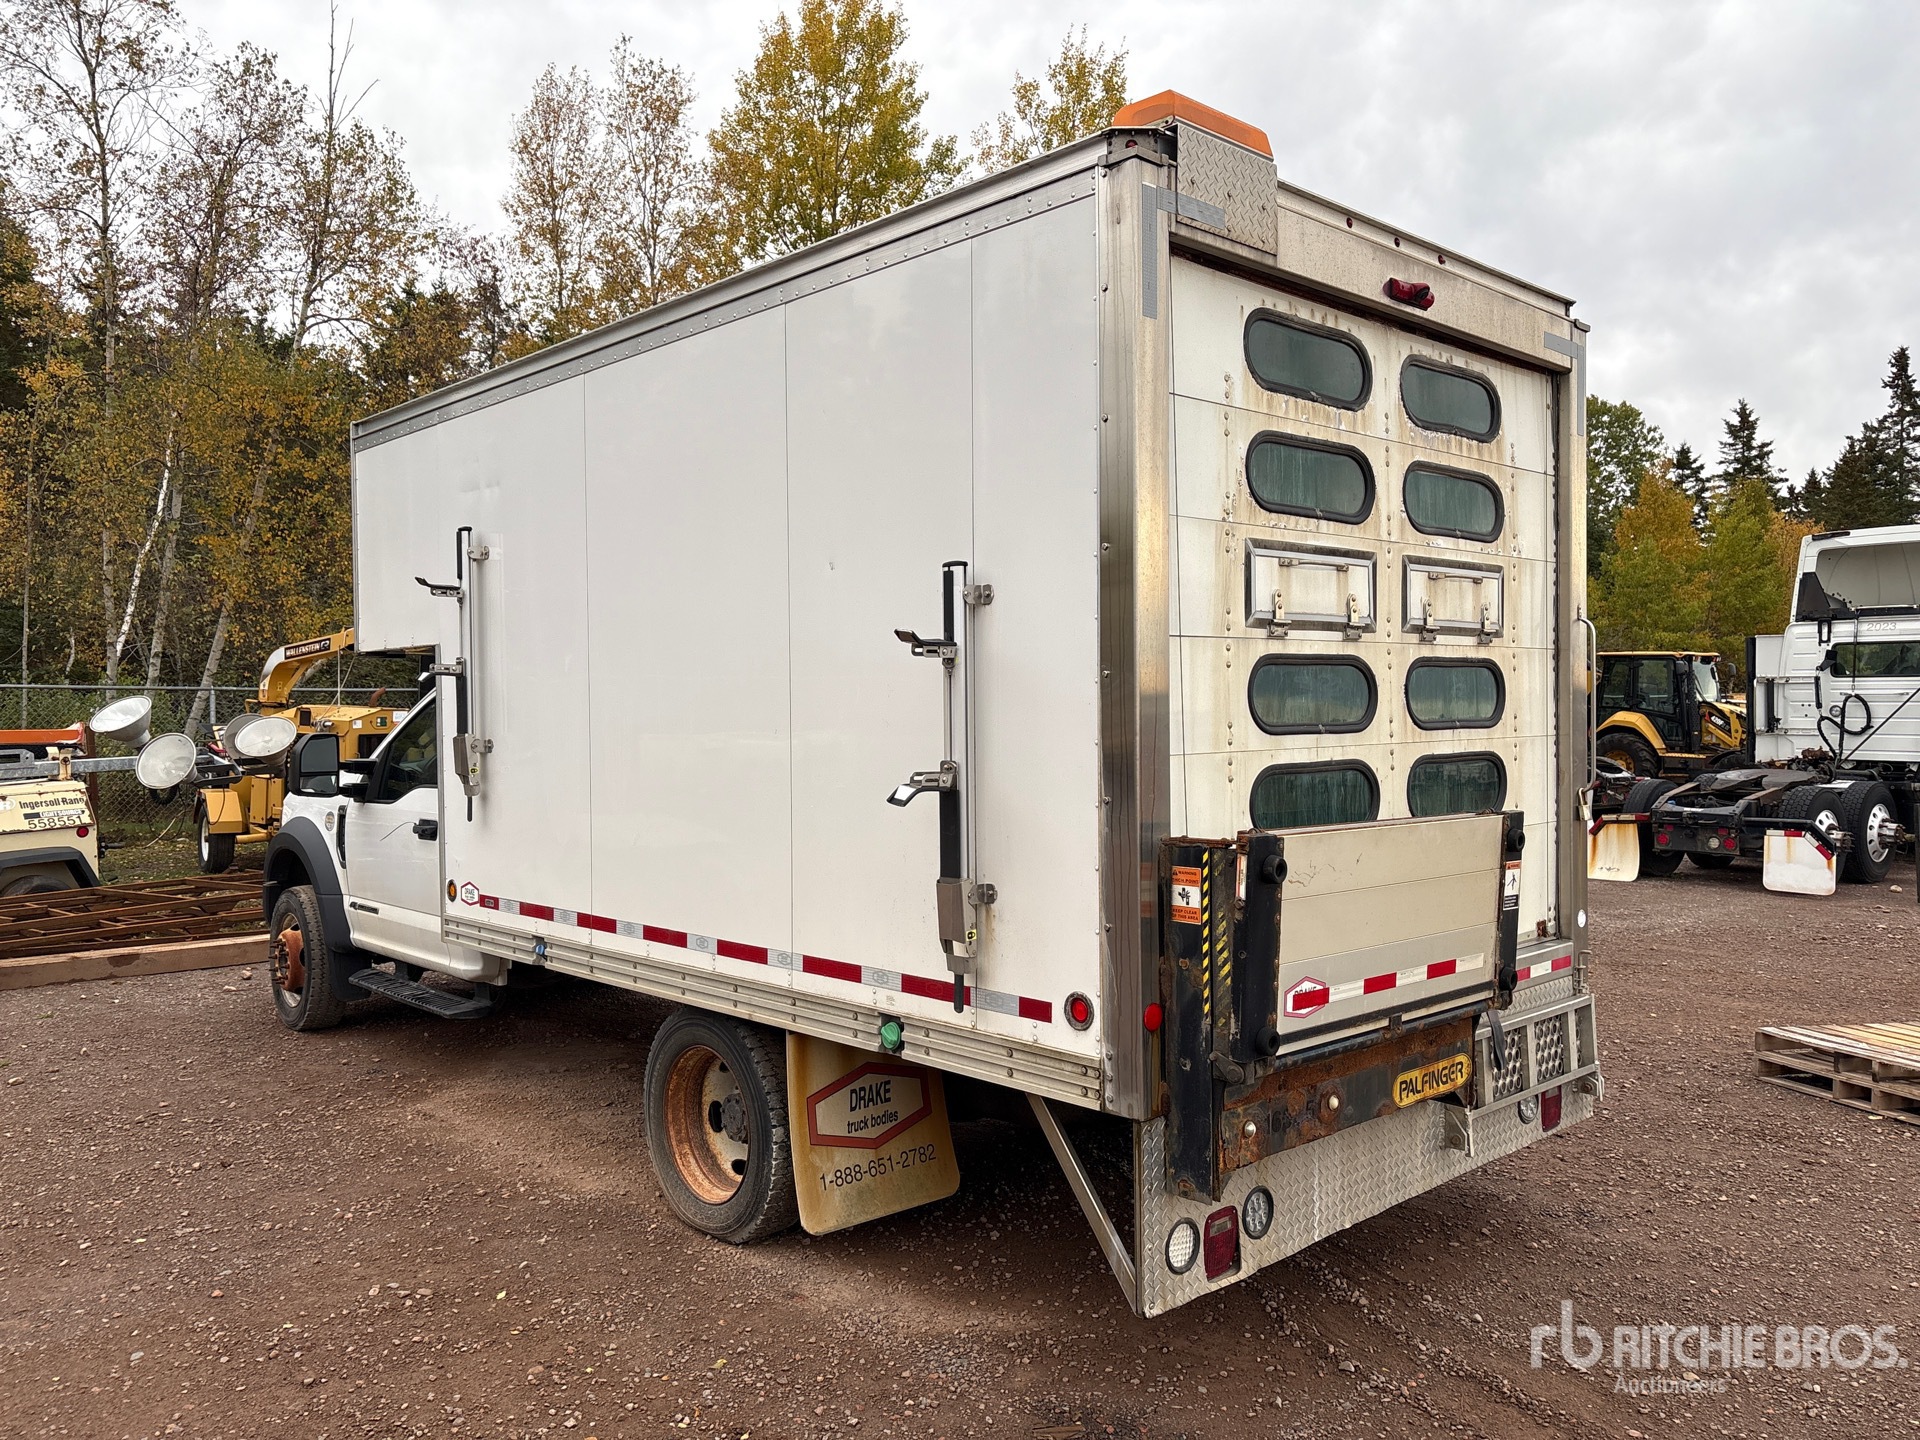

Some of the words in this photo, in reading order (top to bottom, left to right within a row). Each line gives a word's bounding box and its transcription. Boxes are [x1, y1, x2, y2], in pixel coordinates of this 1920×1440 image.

[1866, 622, 1897, 631] 2023
[28, 816, 83, 829] 558551
[1399, 1060, 1464, 1100] PALFINGER
[850, 1080, 891, 1112] DRAKE
[847, 1114, 869, 1134] truck
[870, 1110, 899, 1128] bodies
[820, 1143, 937, 1191] 1-888-651-2782
